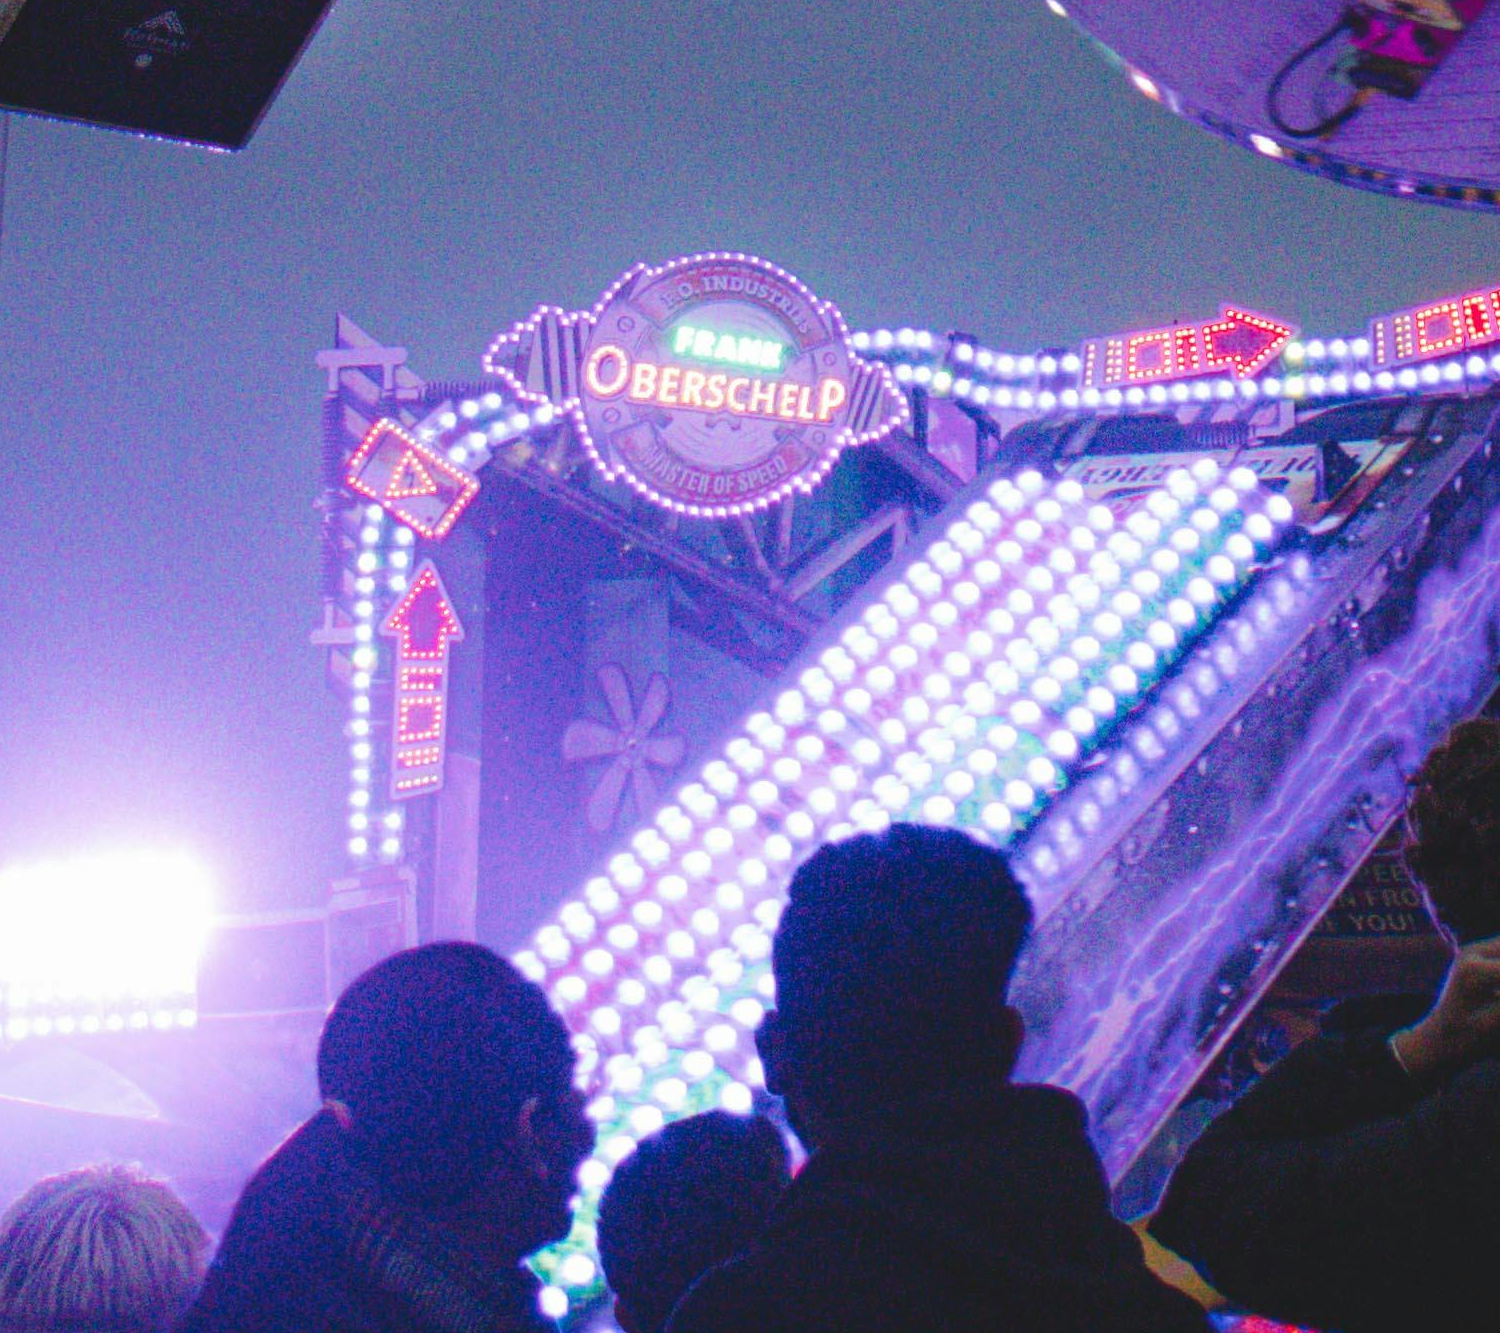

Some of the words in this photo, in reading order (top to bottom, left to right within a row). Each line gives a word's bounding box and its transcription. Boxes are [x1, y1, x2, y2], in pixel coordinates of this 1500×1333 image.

[672, 325, 783, 369] FRANK
[585, 344, 847, 423] OBERSCHELP
[641, 446, 709, 493] MASTER
[713, 473, 735, 495] OF
[738, 455, 788, 492] SPEED
